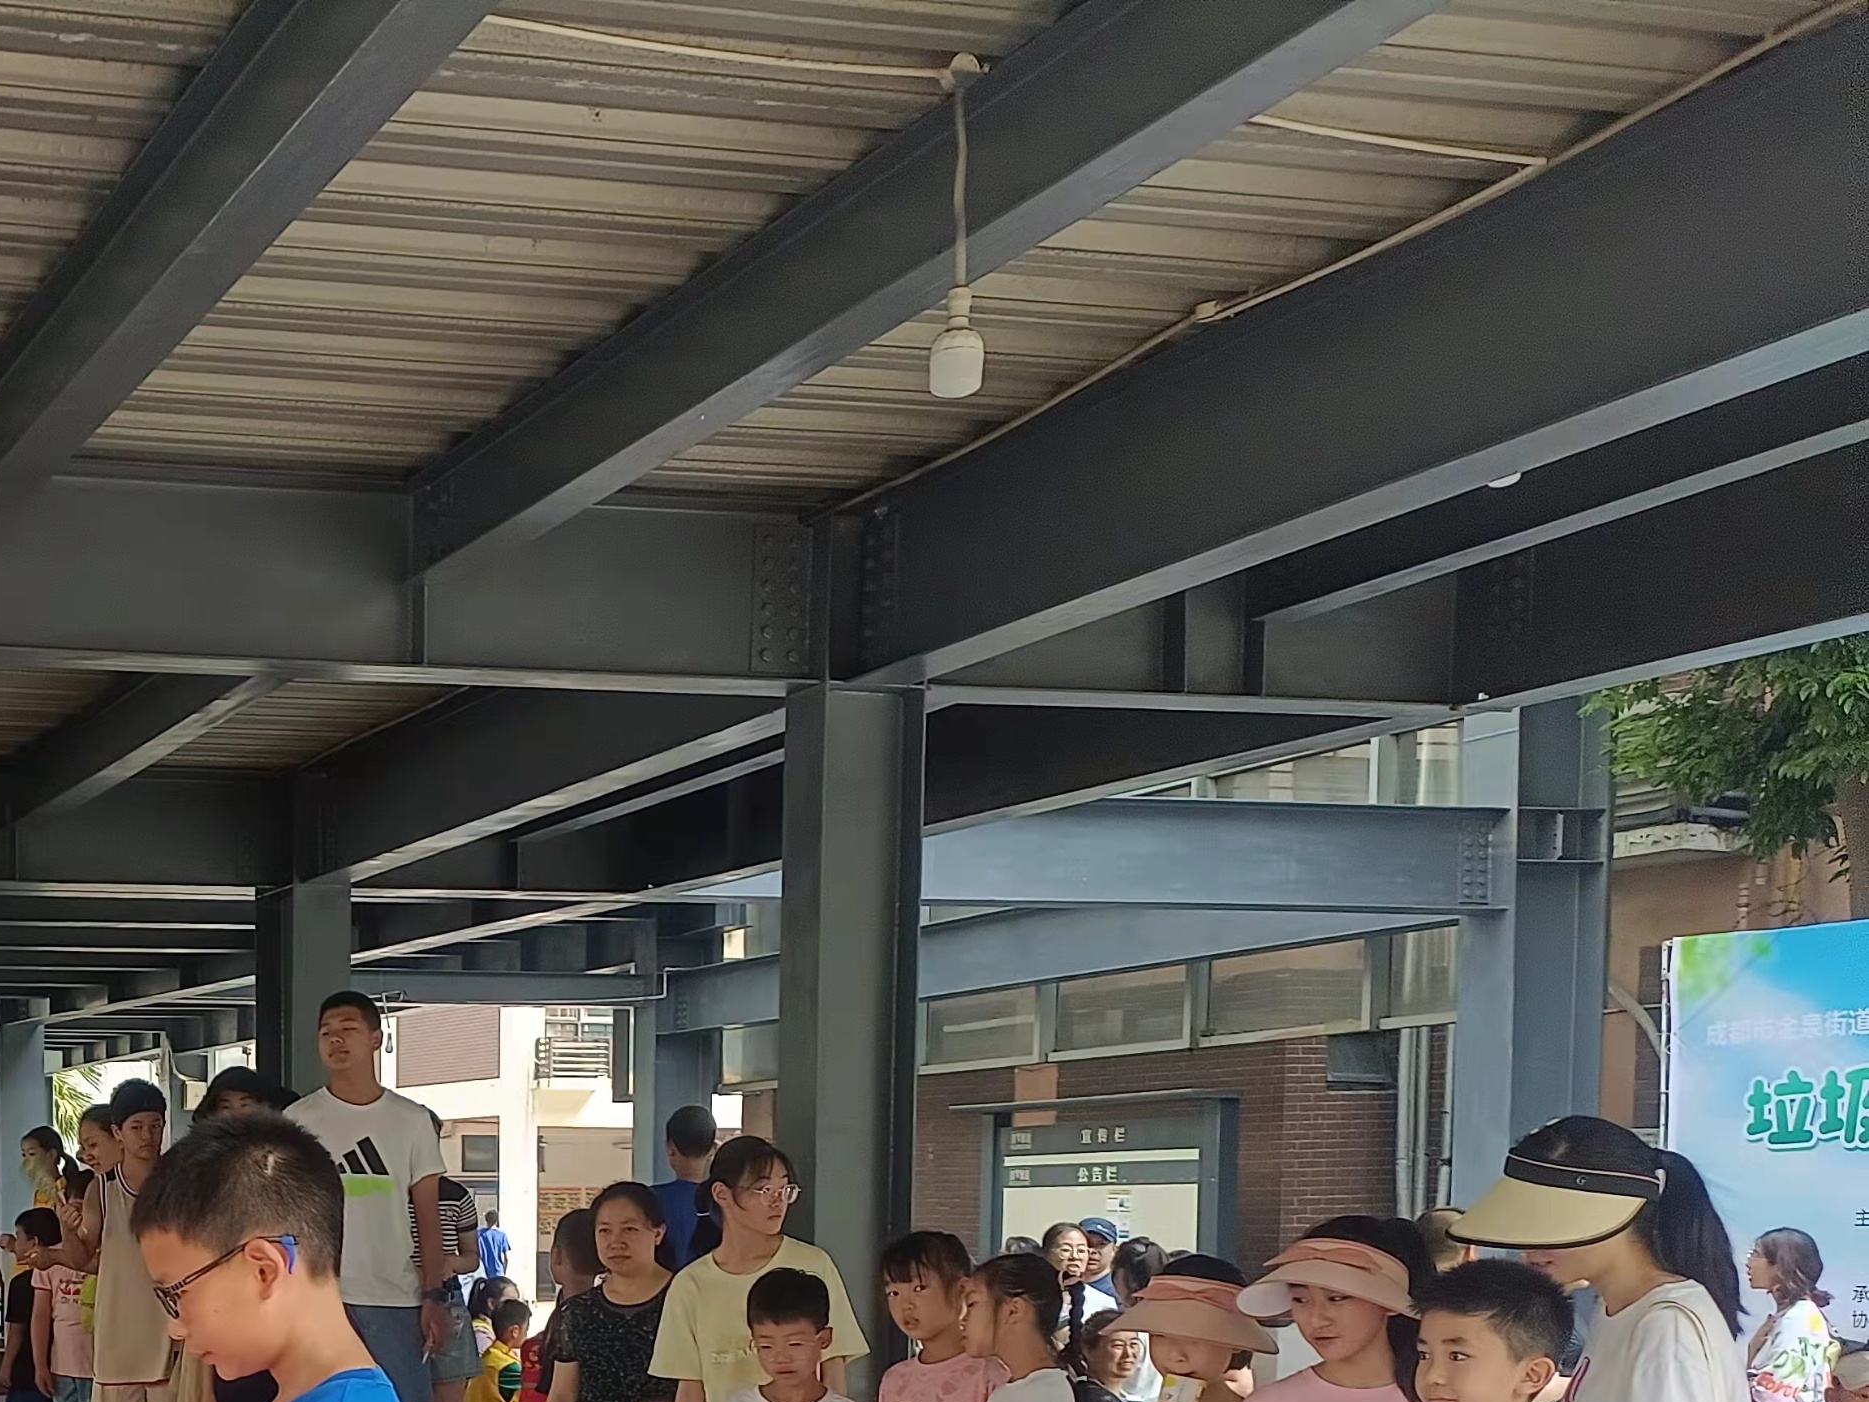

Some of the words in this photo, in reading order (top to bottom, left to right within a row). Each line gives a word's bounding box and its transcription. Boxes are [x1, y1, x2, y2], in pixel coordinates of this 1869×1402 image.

[1079, 1127, 1127, 1145] 宣传栏
[1076, 1166, 1120, 1184] 公告栏
